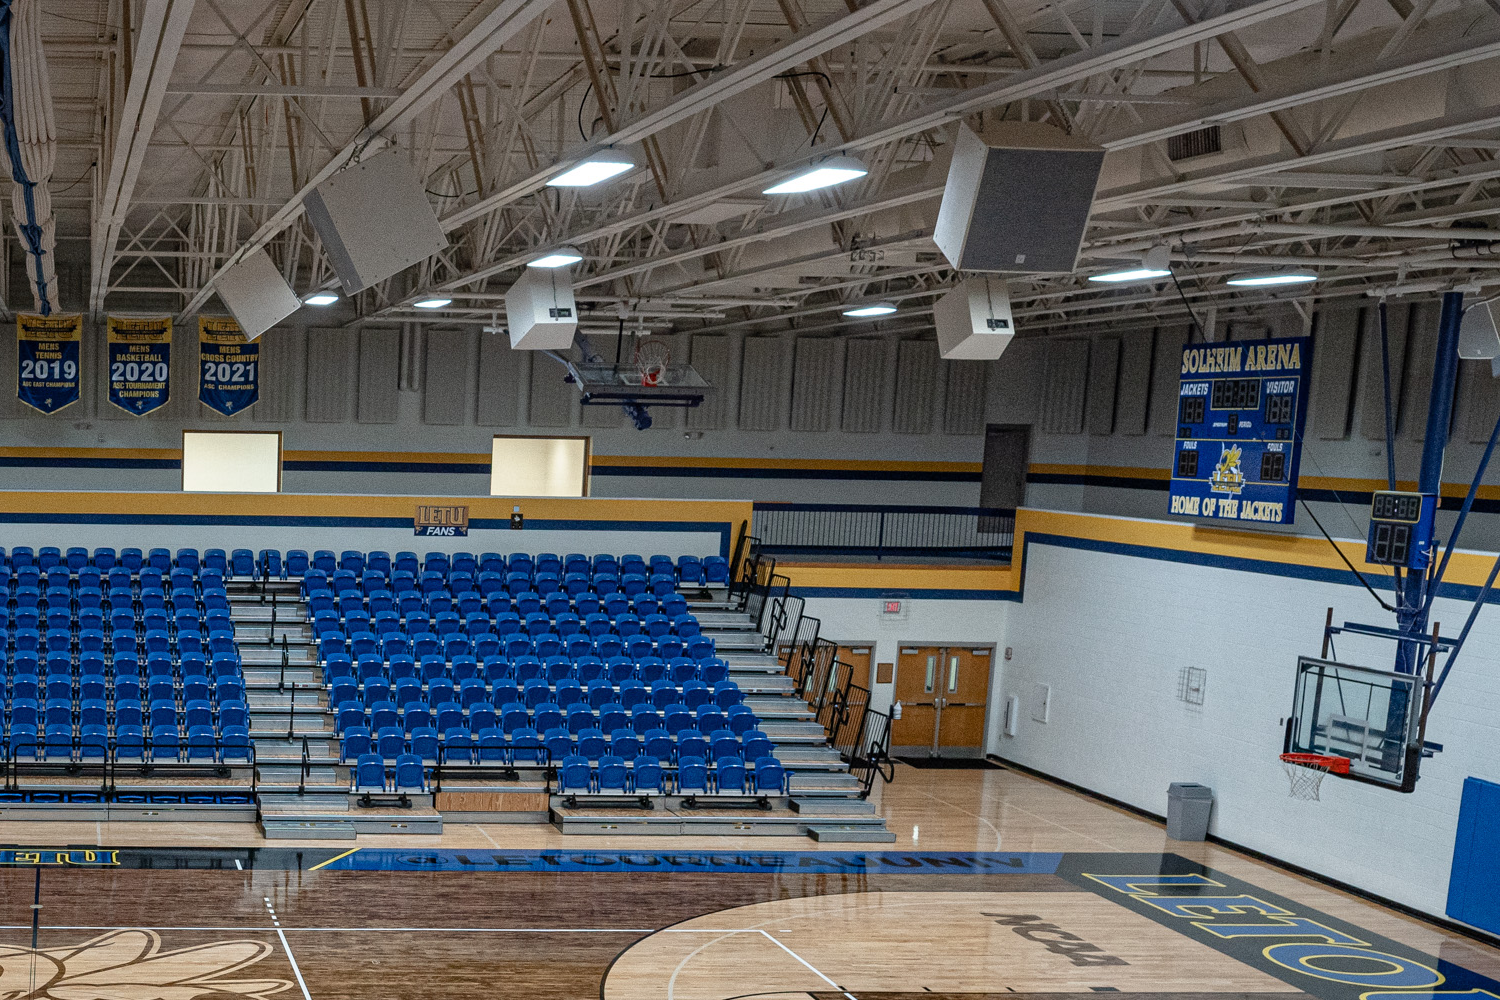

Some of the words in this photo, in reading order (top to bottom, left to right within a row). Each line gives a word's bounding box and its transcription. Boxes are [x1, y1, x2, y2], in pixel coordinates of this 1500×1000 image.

[201, 353, 224, 362] CROSS
[226, 354, 258, 362] COUNTRY
[219, 346, 241, 354] MENS
[1181, 347, 1243, 374] SOLHEIM
[1245, 343, 1300, 371] ARENA
[21, 360, 76, 379] 2019
[112, 362, 168, 381] 2020
[204, 363, 254, 382] 2021
[1180, 383, 1209, 396] JACKETS
[1266, 380, 1295, 394] VISITOR
[1183, 441, 1197, 450] FOULS
[1267, 443, 1283, 451] FOULS
[418, 506, 465, 525] LETU
[1171, 495, 1200, 516] HOME
[1202, 499, 1215, 516] OF
[1218, 500, 1238, 519] THE
[1240, 500, 1283, 522] JACKETS
[426, 527, 455, 536] FANS
[980, 912, 1131, 967] NCAA
